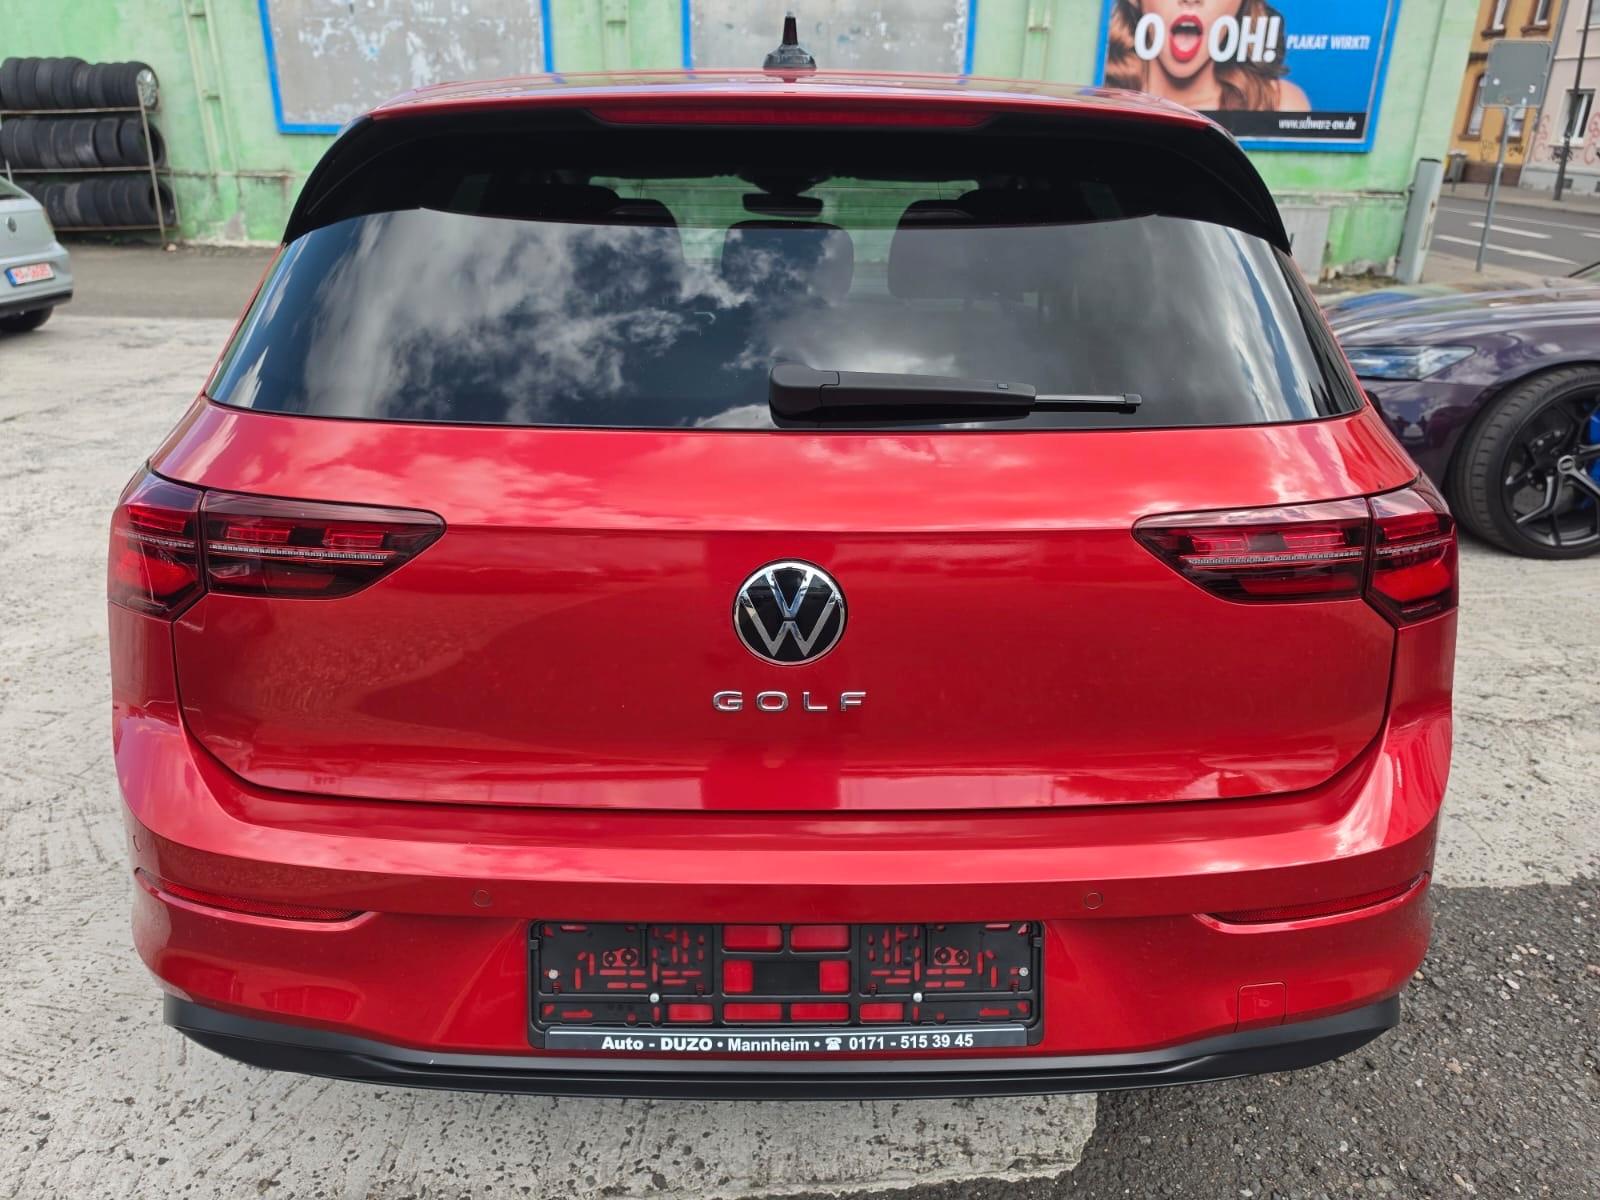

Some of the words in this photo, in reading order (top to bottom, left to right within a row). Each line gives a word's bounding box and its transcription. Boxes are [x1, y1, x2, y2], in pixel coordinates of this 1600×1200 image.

[1208, 15, 1281, 63] OH!
[1286, 34, 1328, 50] PLAKAT
[1331, 35, 1371, 50] WIRKT!
[713, 690, 867, 712] GOLF
[601, 1036, 644, 1051] Auto
[660, 1038, 713, 1051] DUZO
[727, 1038, 810, 1052] Mannheim
[849, 1036, 885, 1050] 0171
[900, 1035, 928, 1049] 515
[932, 1034, 951, 1048] 39
[954, 1033, 974, 1047] 45
